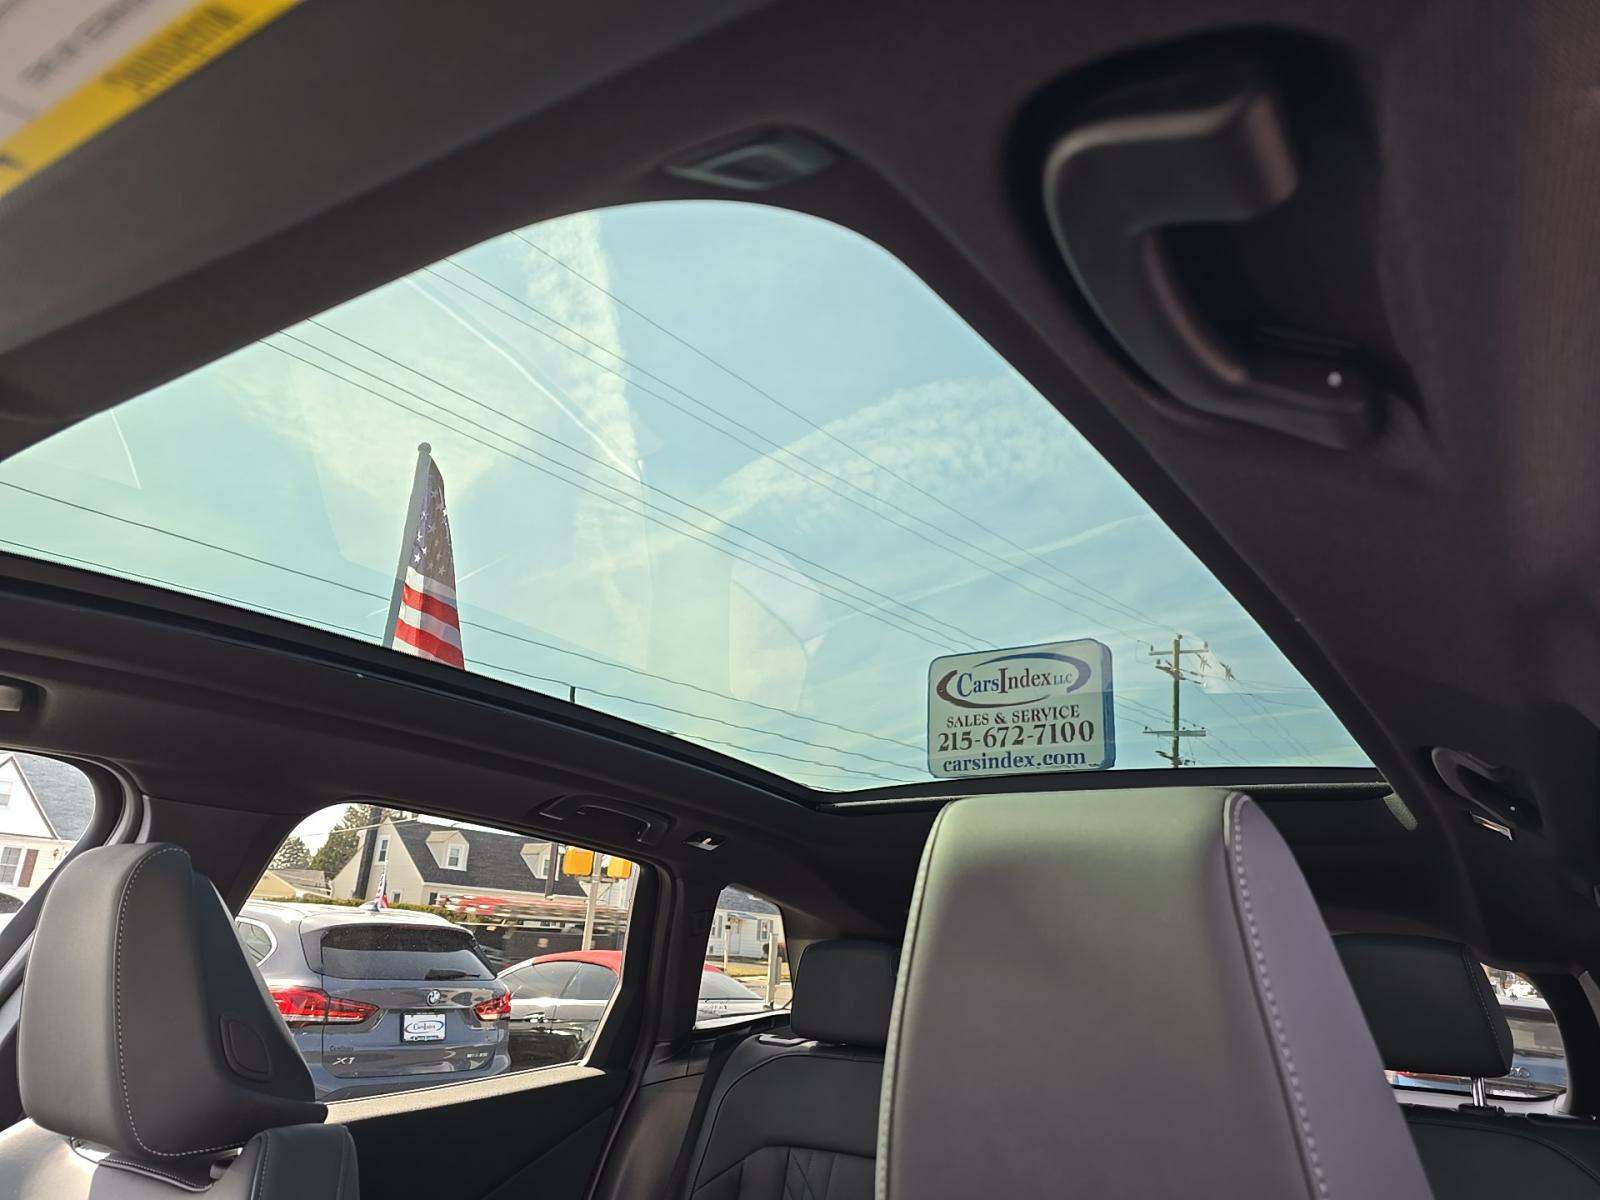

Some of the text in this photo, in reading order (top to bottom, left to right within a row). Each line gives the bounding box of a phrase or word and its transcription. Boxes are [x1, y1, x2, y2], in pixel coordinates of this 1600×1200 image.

[957, 668, 1073, 697] CarsIndex LLC
[946, 704, 1080, 728] SALES & SERVICE
[938, 720, 1094, 752] 215-672-7100
[943, 752, 1086, 772] carsindex.com
[332, 1056, 356, 1066] X1
